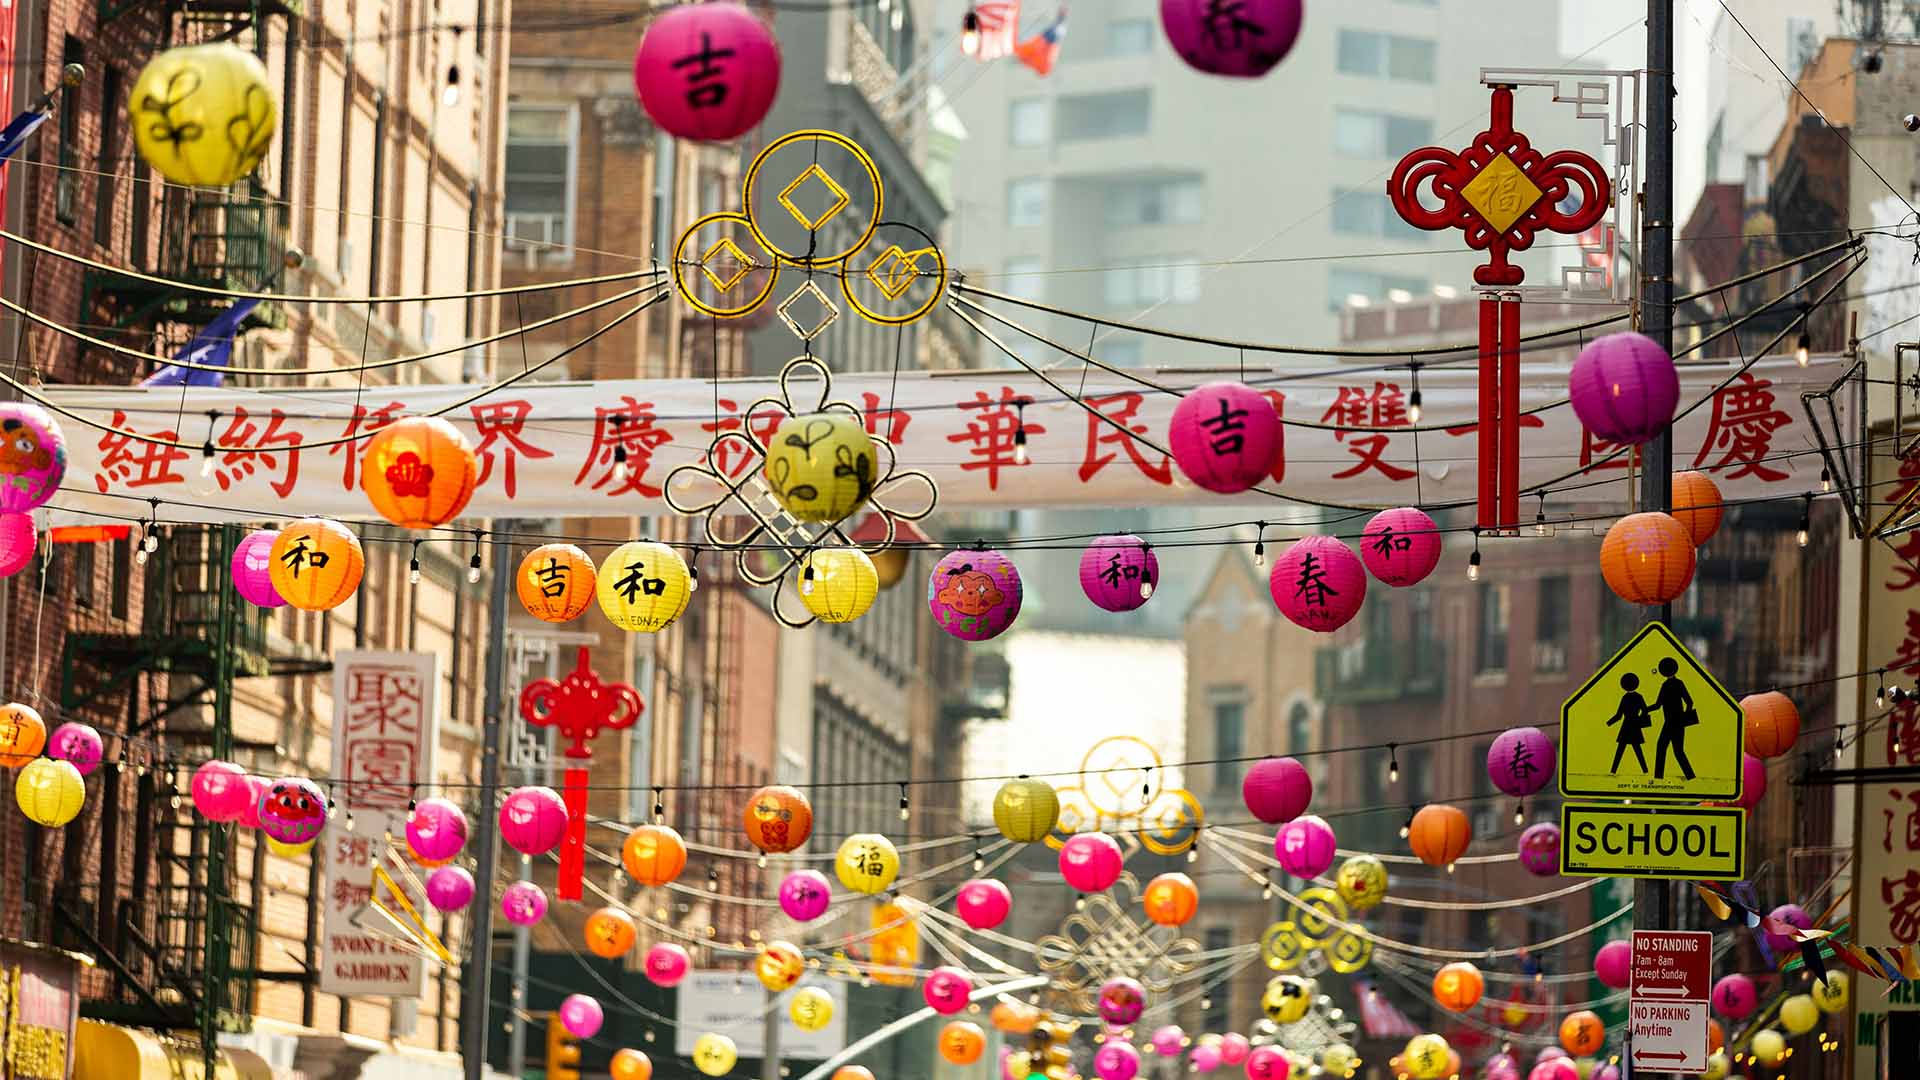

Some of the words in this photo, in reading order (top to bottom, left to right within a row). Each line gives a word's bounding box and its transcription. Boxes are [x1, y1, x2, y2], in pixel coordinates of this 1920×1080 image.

[671, 32, 736, 109] 吉
[1479, 169, 1524, 216] 福
[1200, 398, 1249, 456] 吉
[280, 535, 330, 579] 和
[1373, 526, 1412, 560] 和
[535, 557, 570, 598] 吉
[613, 561, 666, 604] 和
[1098, 552, 1139, 589] 和
[1295, 553, 1340, 606] 春
[1510, 740, 1539, 779] 春
[1575, 821, 1730, 858] SCHOOL
[855, 844, 884, 876] 福
[1636, 938, 1650, 951] NO
[1652, 938, 1698, 952] STANDING
[1636, 955, 1651, 966] 7am
[1658, 955, 1674, 966] 8am
[335, 962, 410, 982] GARDEN
[1635, 968, 1659, 980] Except
[1661, 969, 1688, 981] Sunday
[1634, 1007, 1648, 1020] NO
[1650, 1007, 1690, 1021] PARKING
[1634, 1024, 1672, 1039] Anytime
